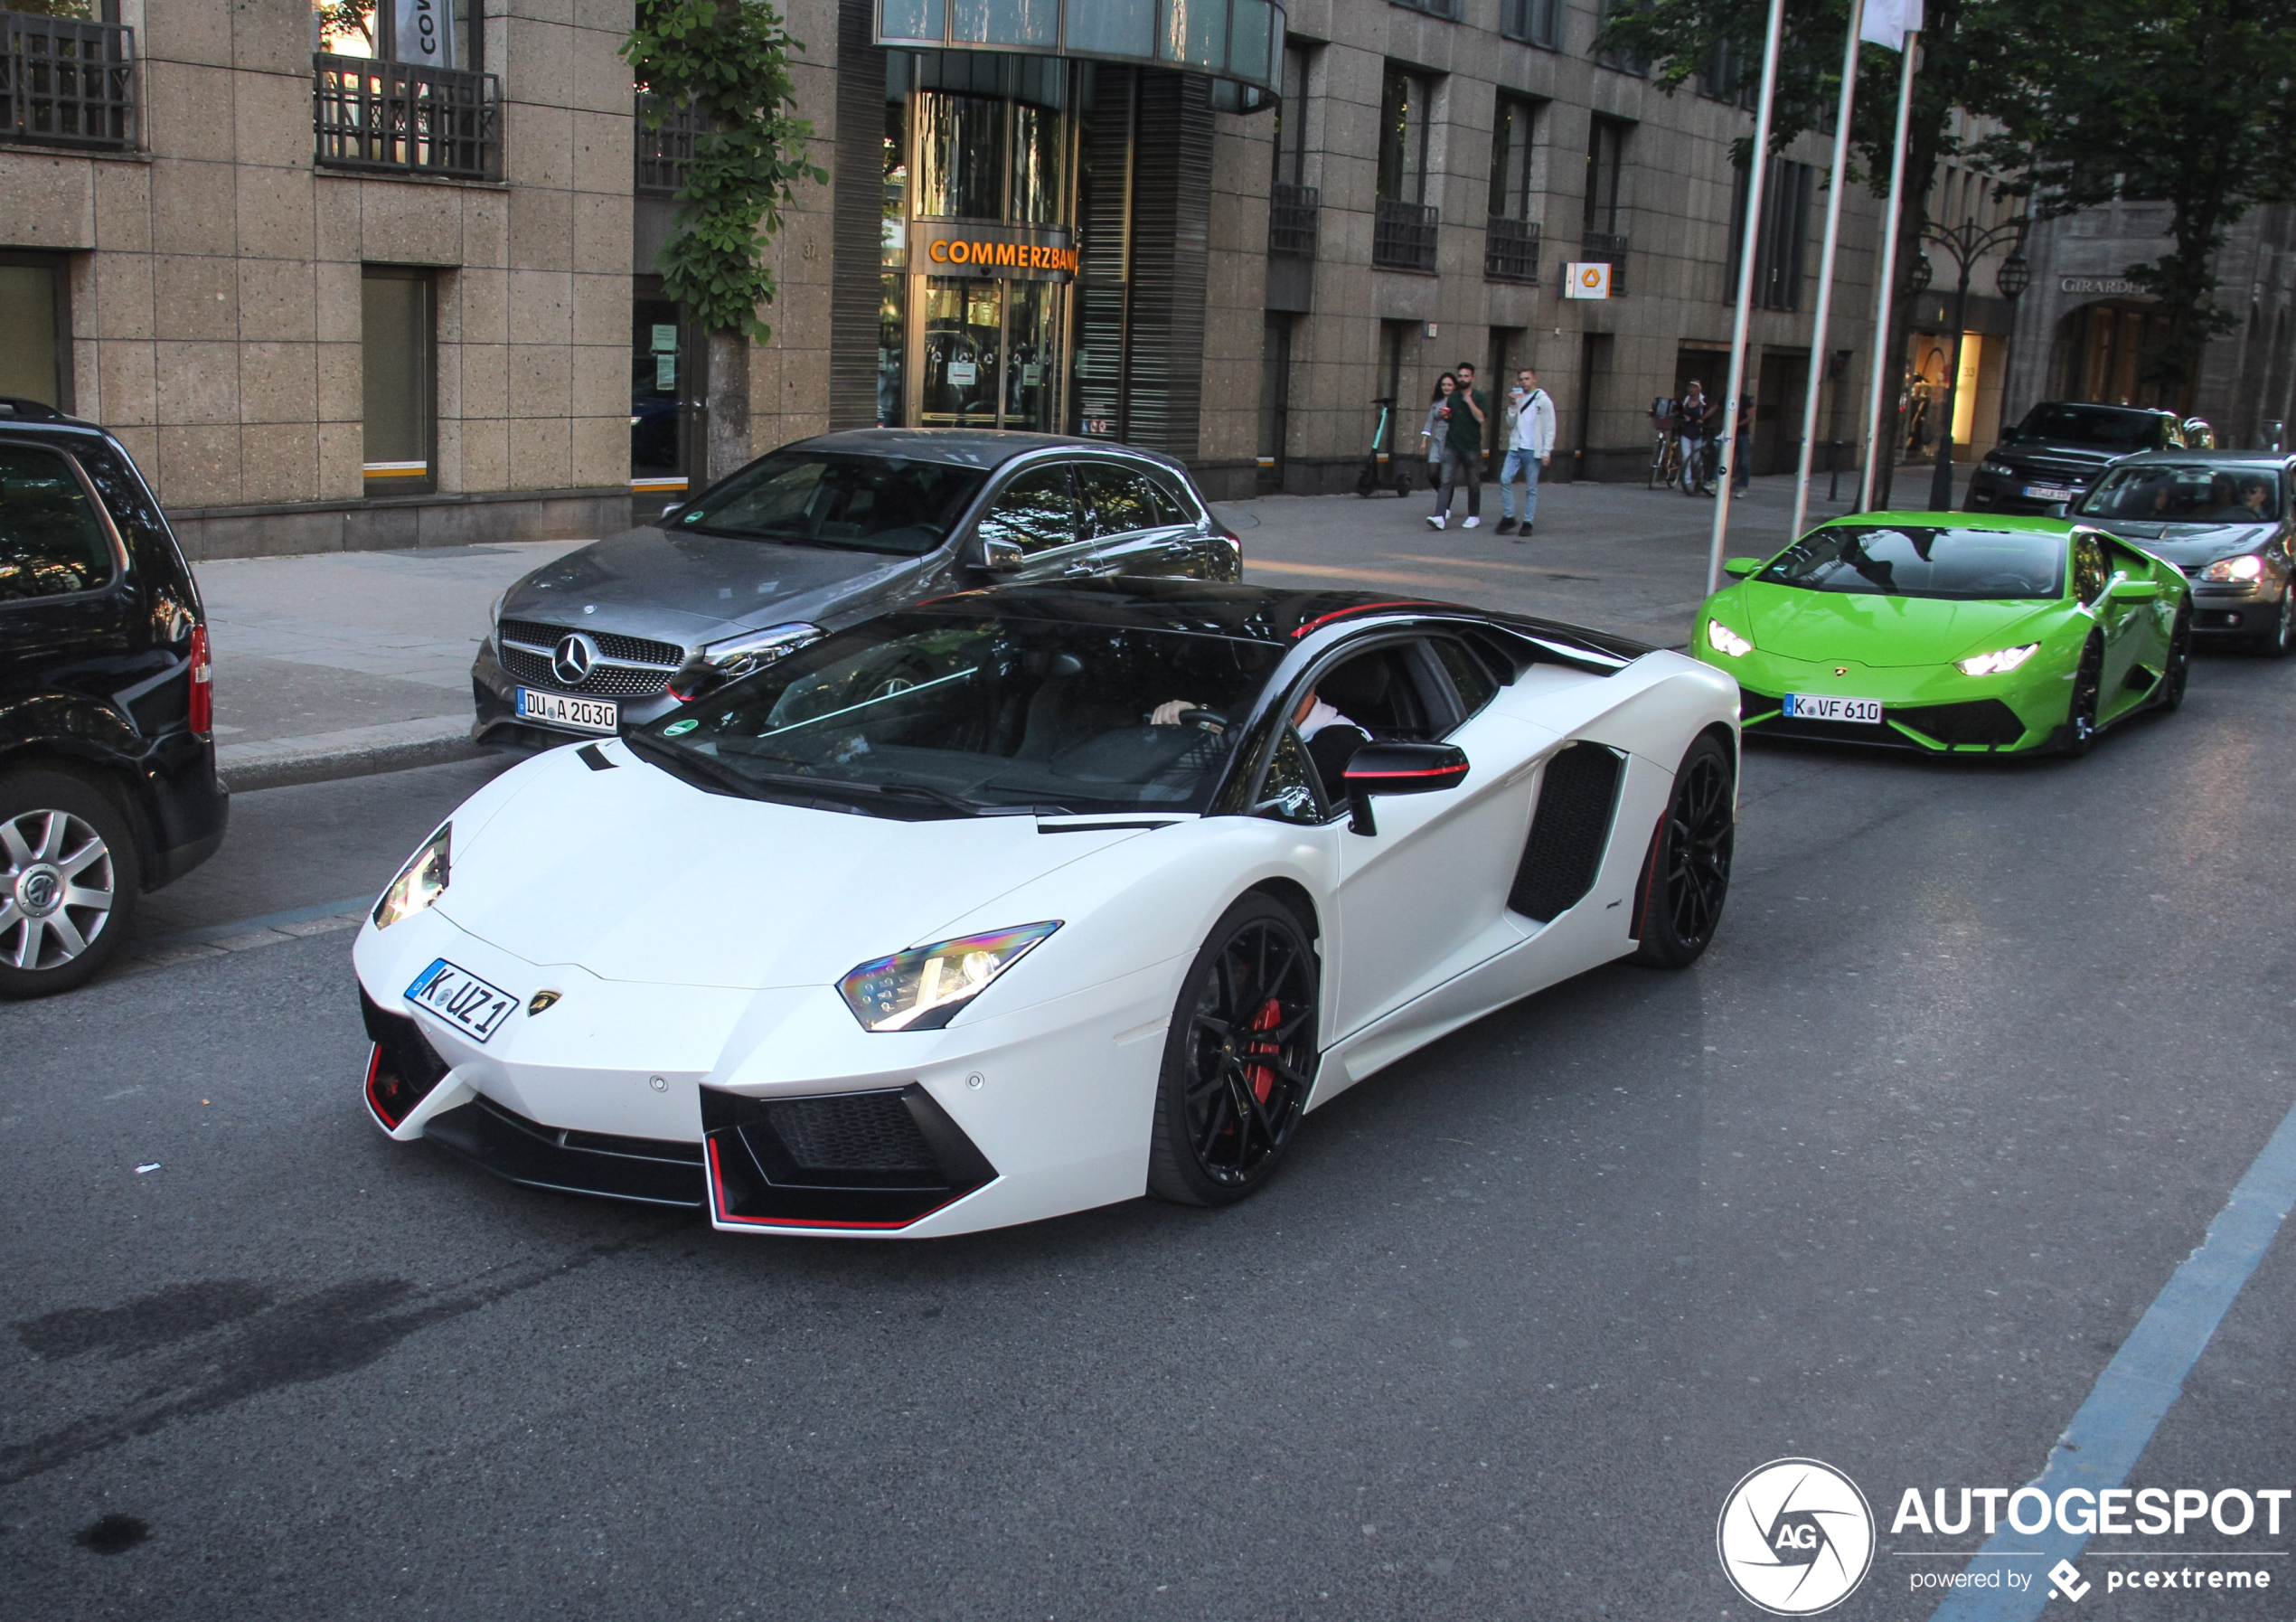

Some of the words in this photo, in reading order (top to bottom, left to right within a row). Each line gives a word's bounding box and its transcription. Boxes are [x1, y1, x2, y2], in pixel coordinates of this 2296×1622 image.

[527, 693, 546, 716] DU
[558, 699, 567, 720] A
[571, 702, 615, 727] 2030
[1794, 698, 1806, 714] K
[1819, 700, 1840, 717] VF
[1844, 702, 1878, 720] 610
[420, 968, 455, 1001] K
